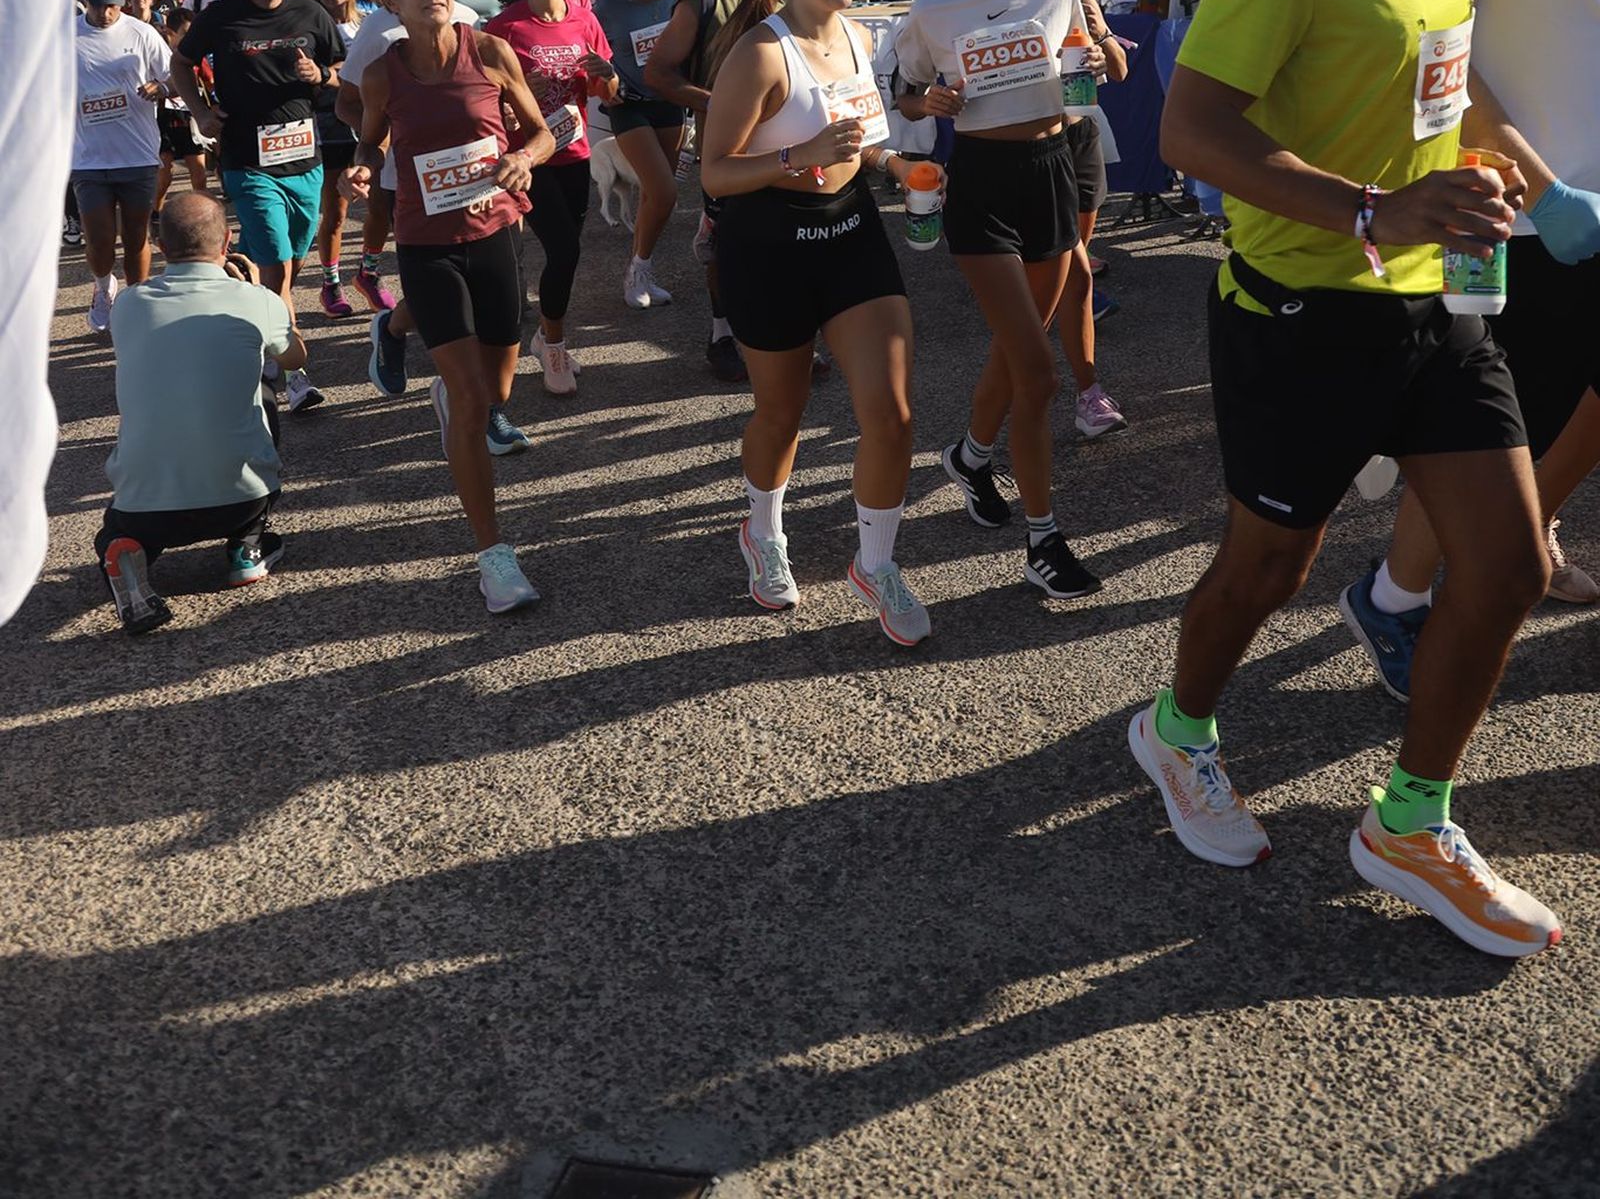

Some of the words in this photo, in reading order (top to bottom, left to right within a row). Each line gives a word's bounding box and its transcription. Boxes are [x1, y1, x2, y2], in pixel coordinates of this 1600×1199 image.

[967, 40, 1042, 71] 24940
[85, 97, 125, 113] 24376
[266, 134, 308, 150] 24391
[796, 227, 829, 240] RUN
[832, 213, 861, 237] HARD
